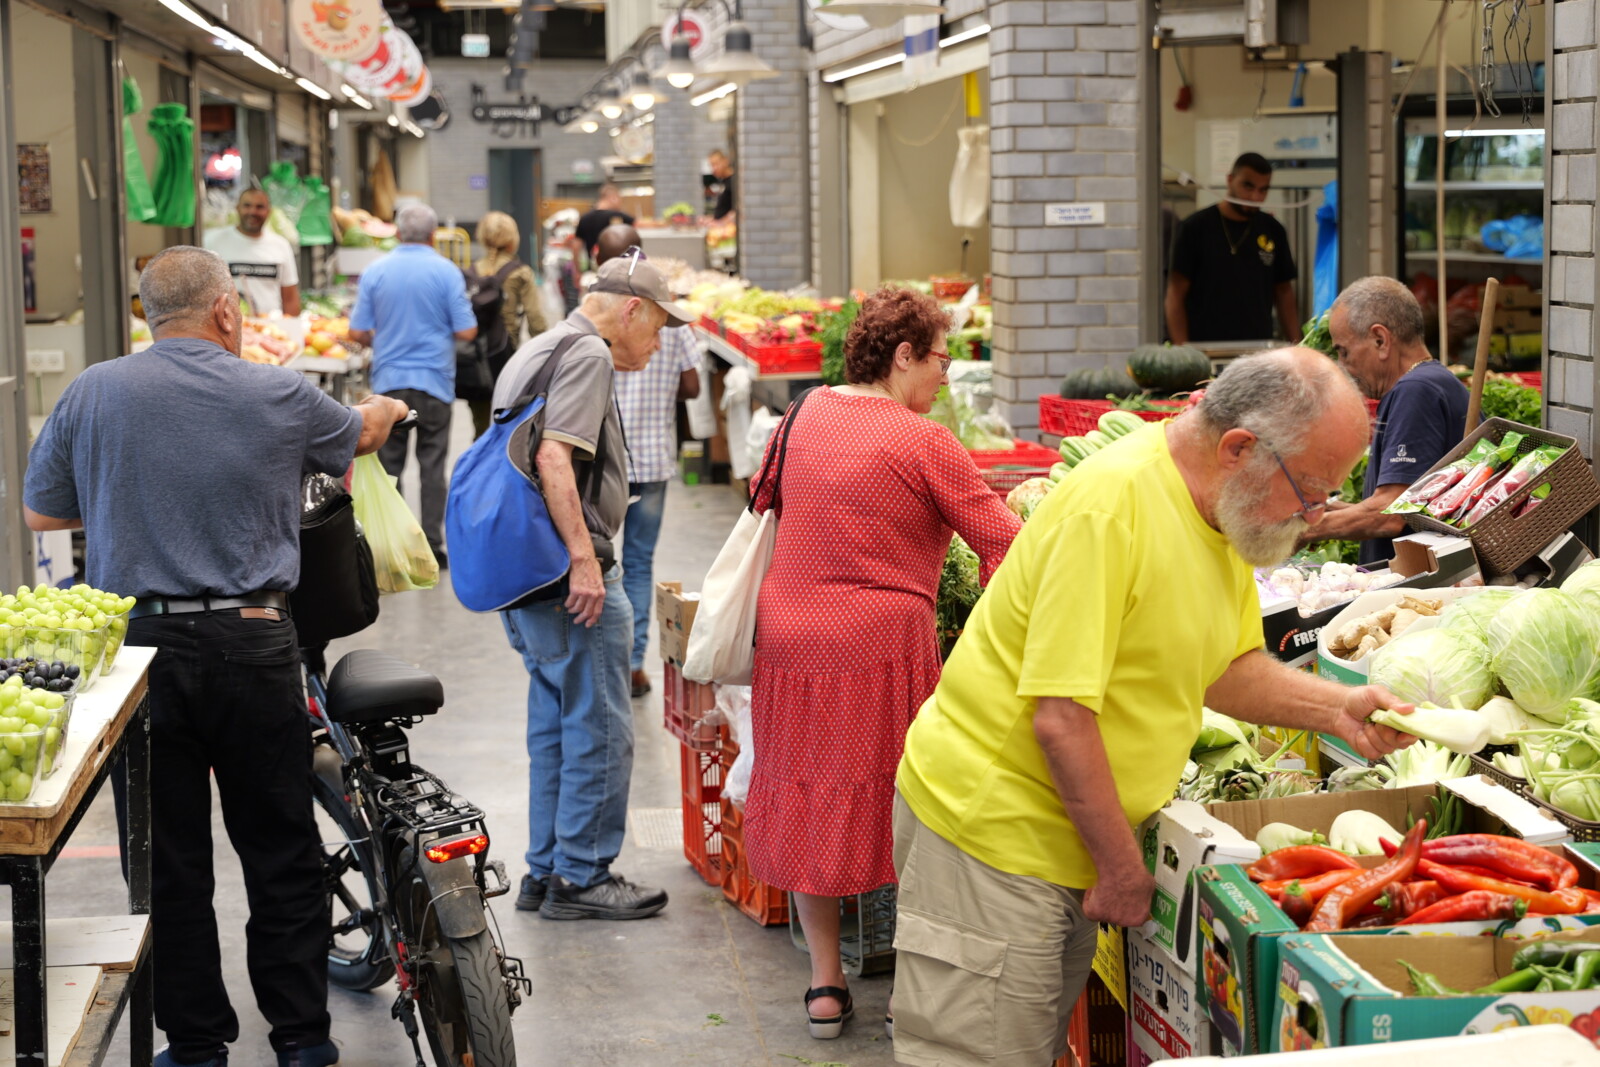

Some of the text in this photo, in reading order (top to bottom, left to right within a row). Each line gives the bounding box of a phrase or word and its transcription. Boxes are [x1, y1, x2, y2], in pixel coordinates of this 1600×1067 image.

[1389, 456, 1417, 464] YACHTING
[1292, 626, 1325, 648] FRES
[1165, 970, 1189, 1013] פירות
